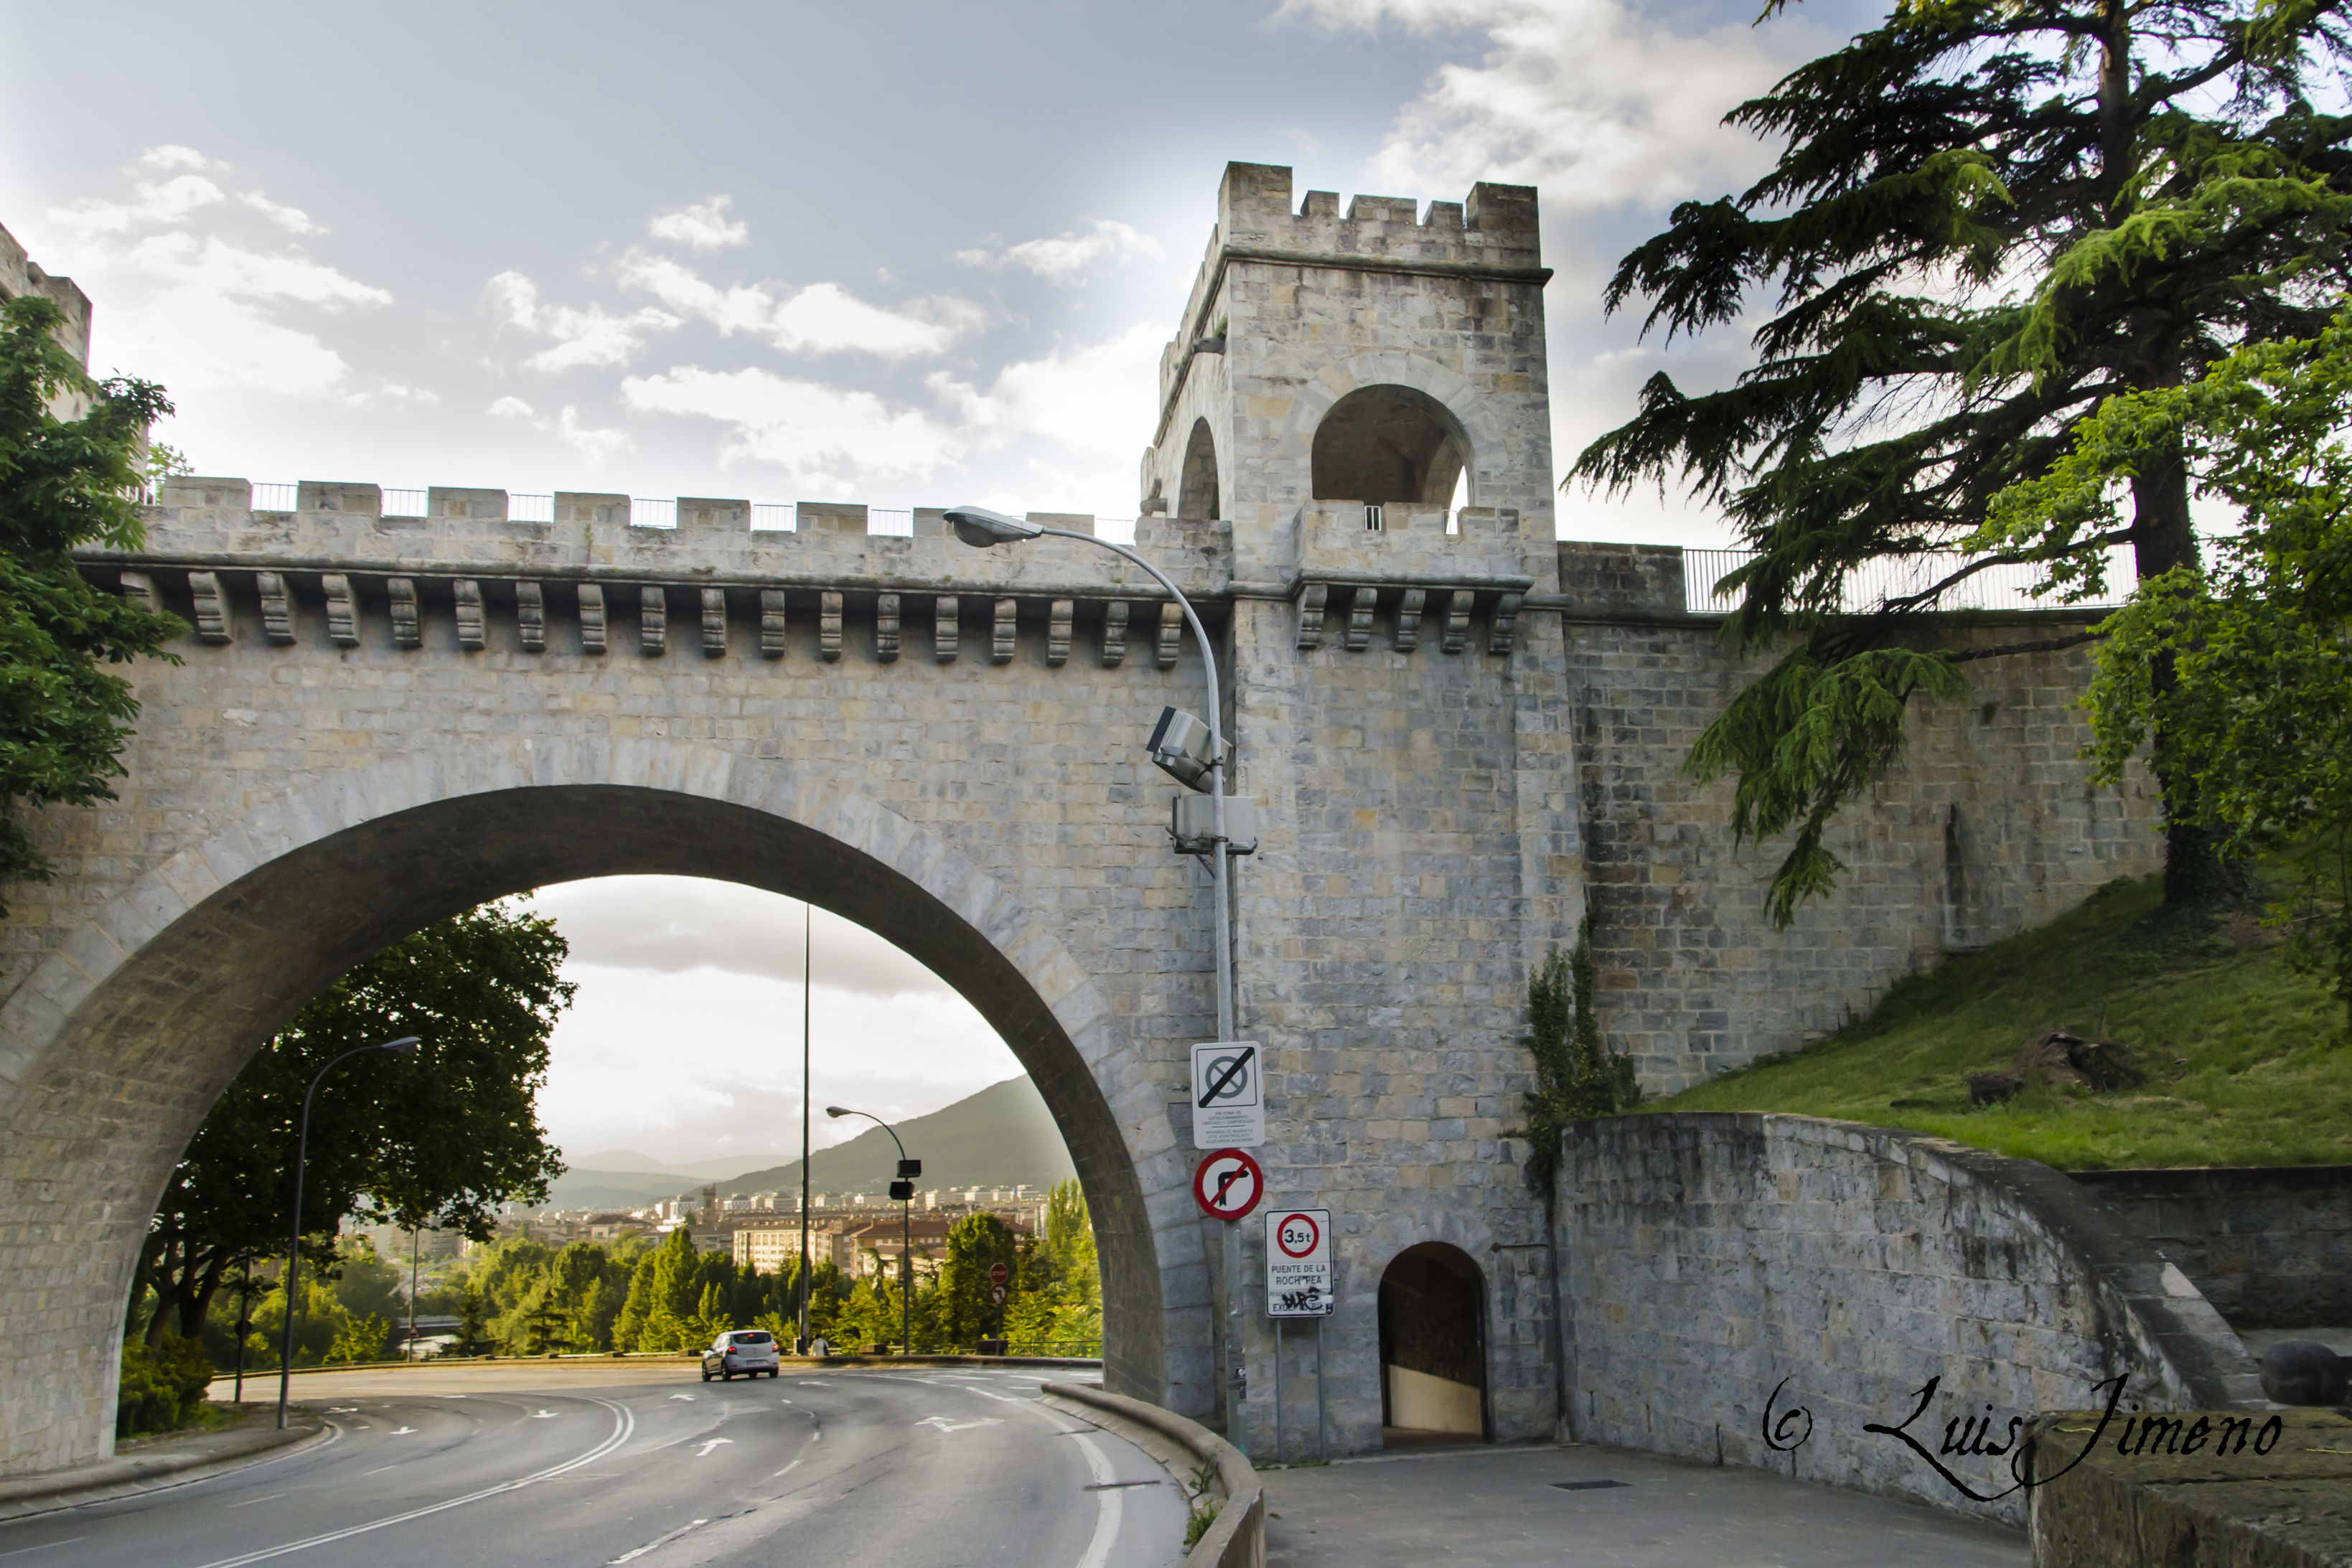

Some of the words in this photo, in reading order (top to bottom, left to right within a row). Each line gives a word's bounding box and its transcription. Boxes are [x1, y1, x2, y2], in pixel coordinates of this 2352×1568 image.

[1284, 1229, 1304, 1244] 3,5
[1306, 1233, 1311, 1242] t
[1276, 1276, 1322, 1285] ROCHPEA
